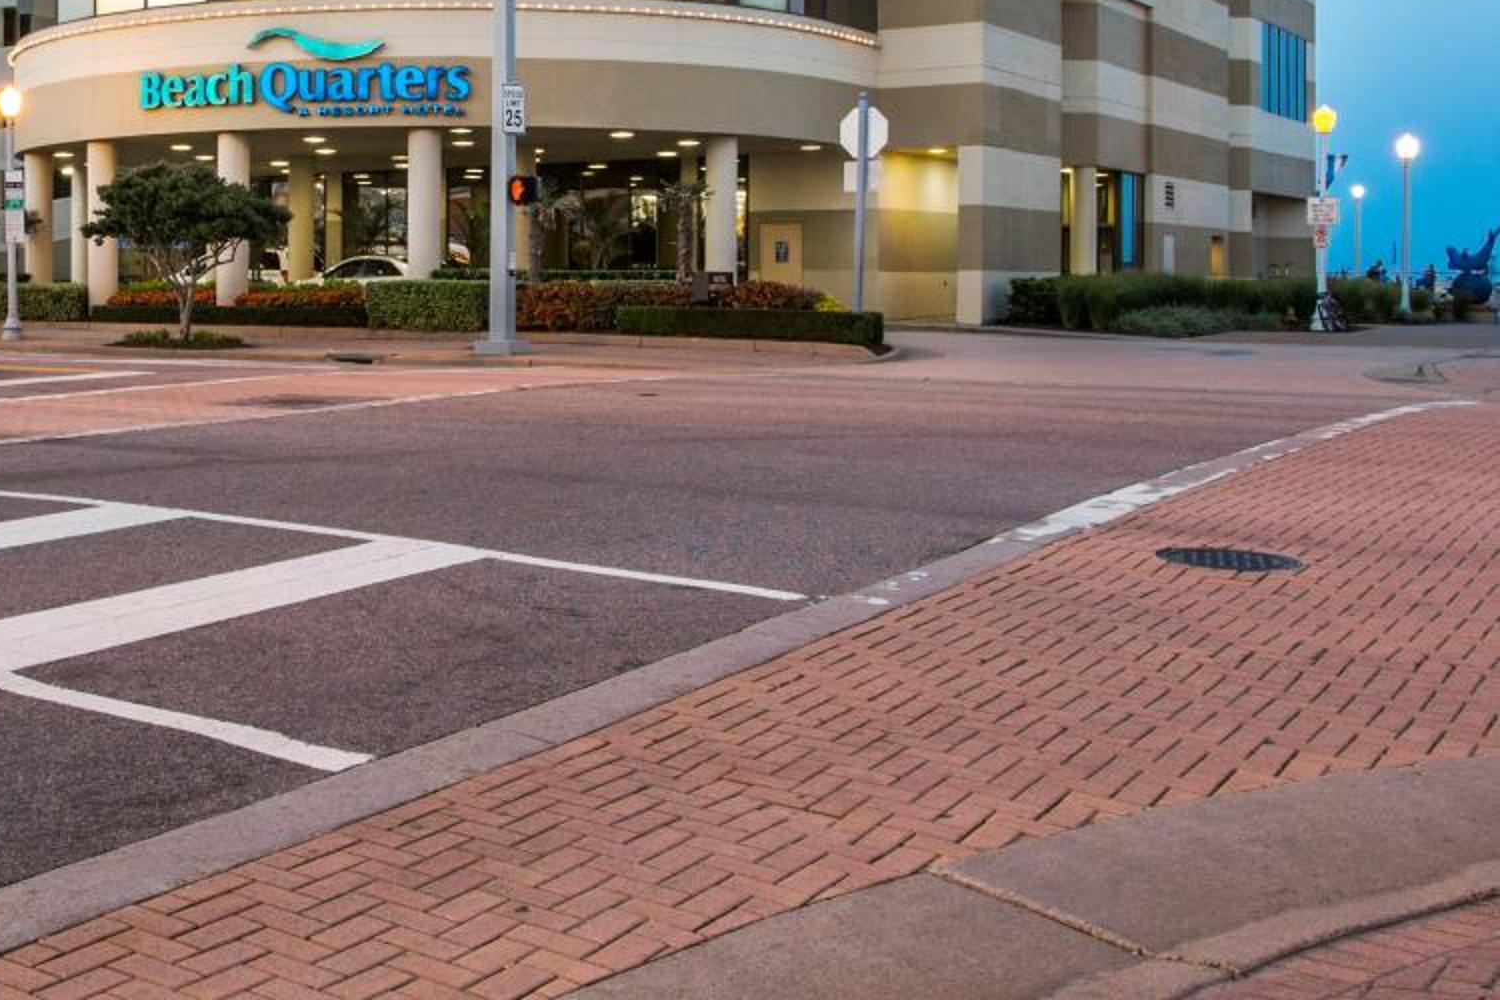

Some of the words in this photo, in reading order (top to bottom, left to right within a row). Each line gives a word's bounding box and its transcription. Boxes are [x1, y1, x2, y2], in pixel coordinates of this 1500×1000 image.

[139, 62, 255, 110] Beach
[259, 61, 472, 114] Quarters
[506, 109, 523, 126] 25
